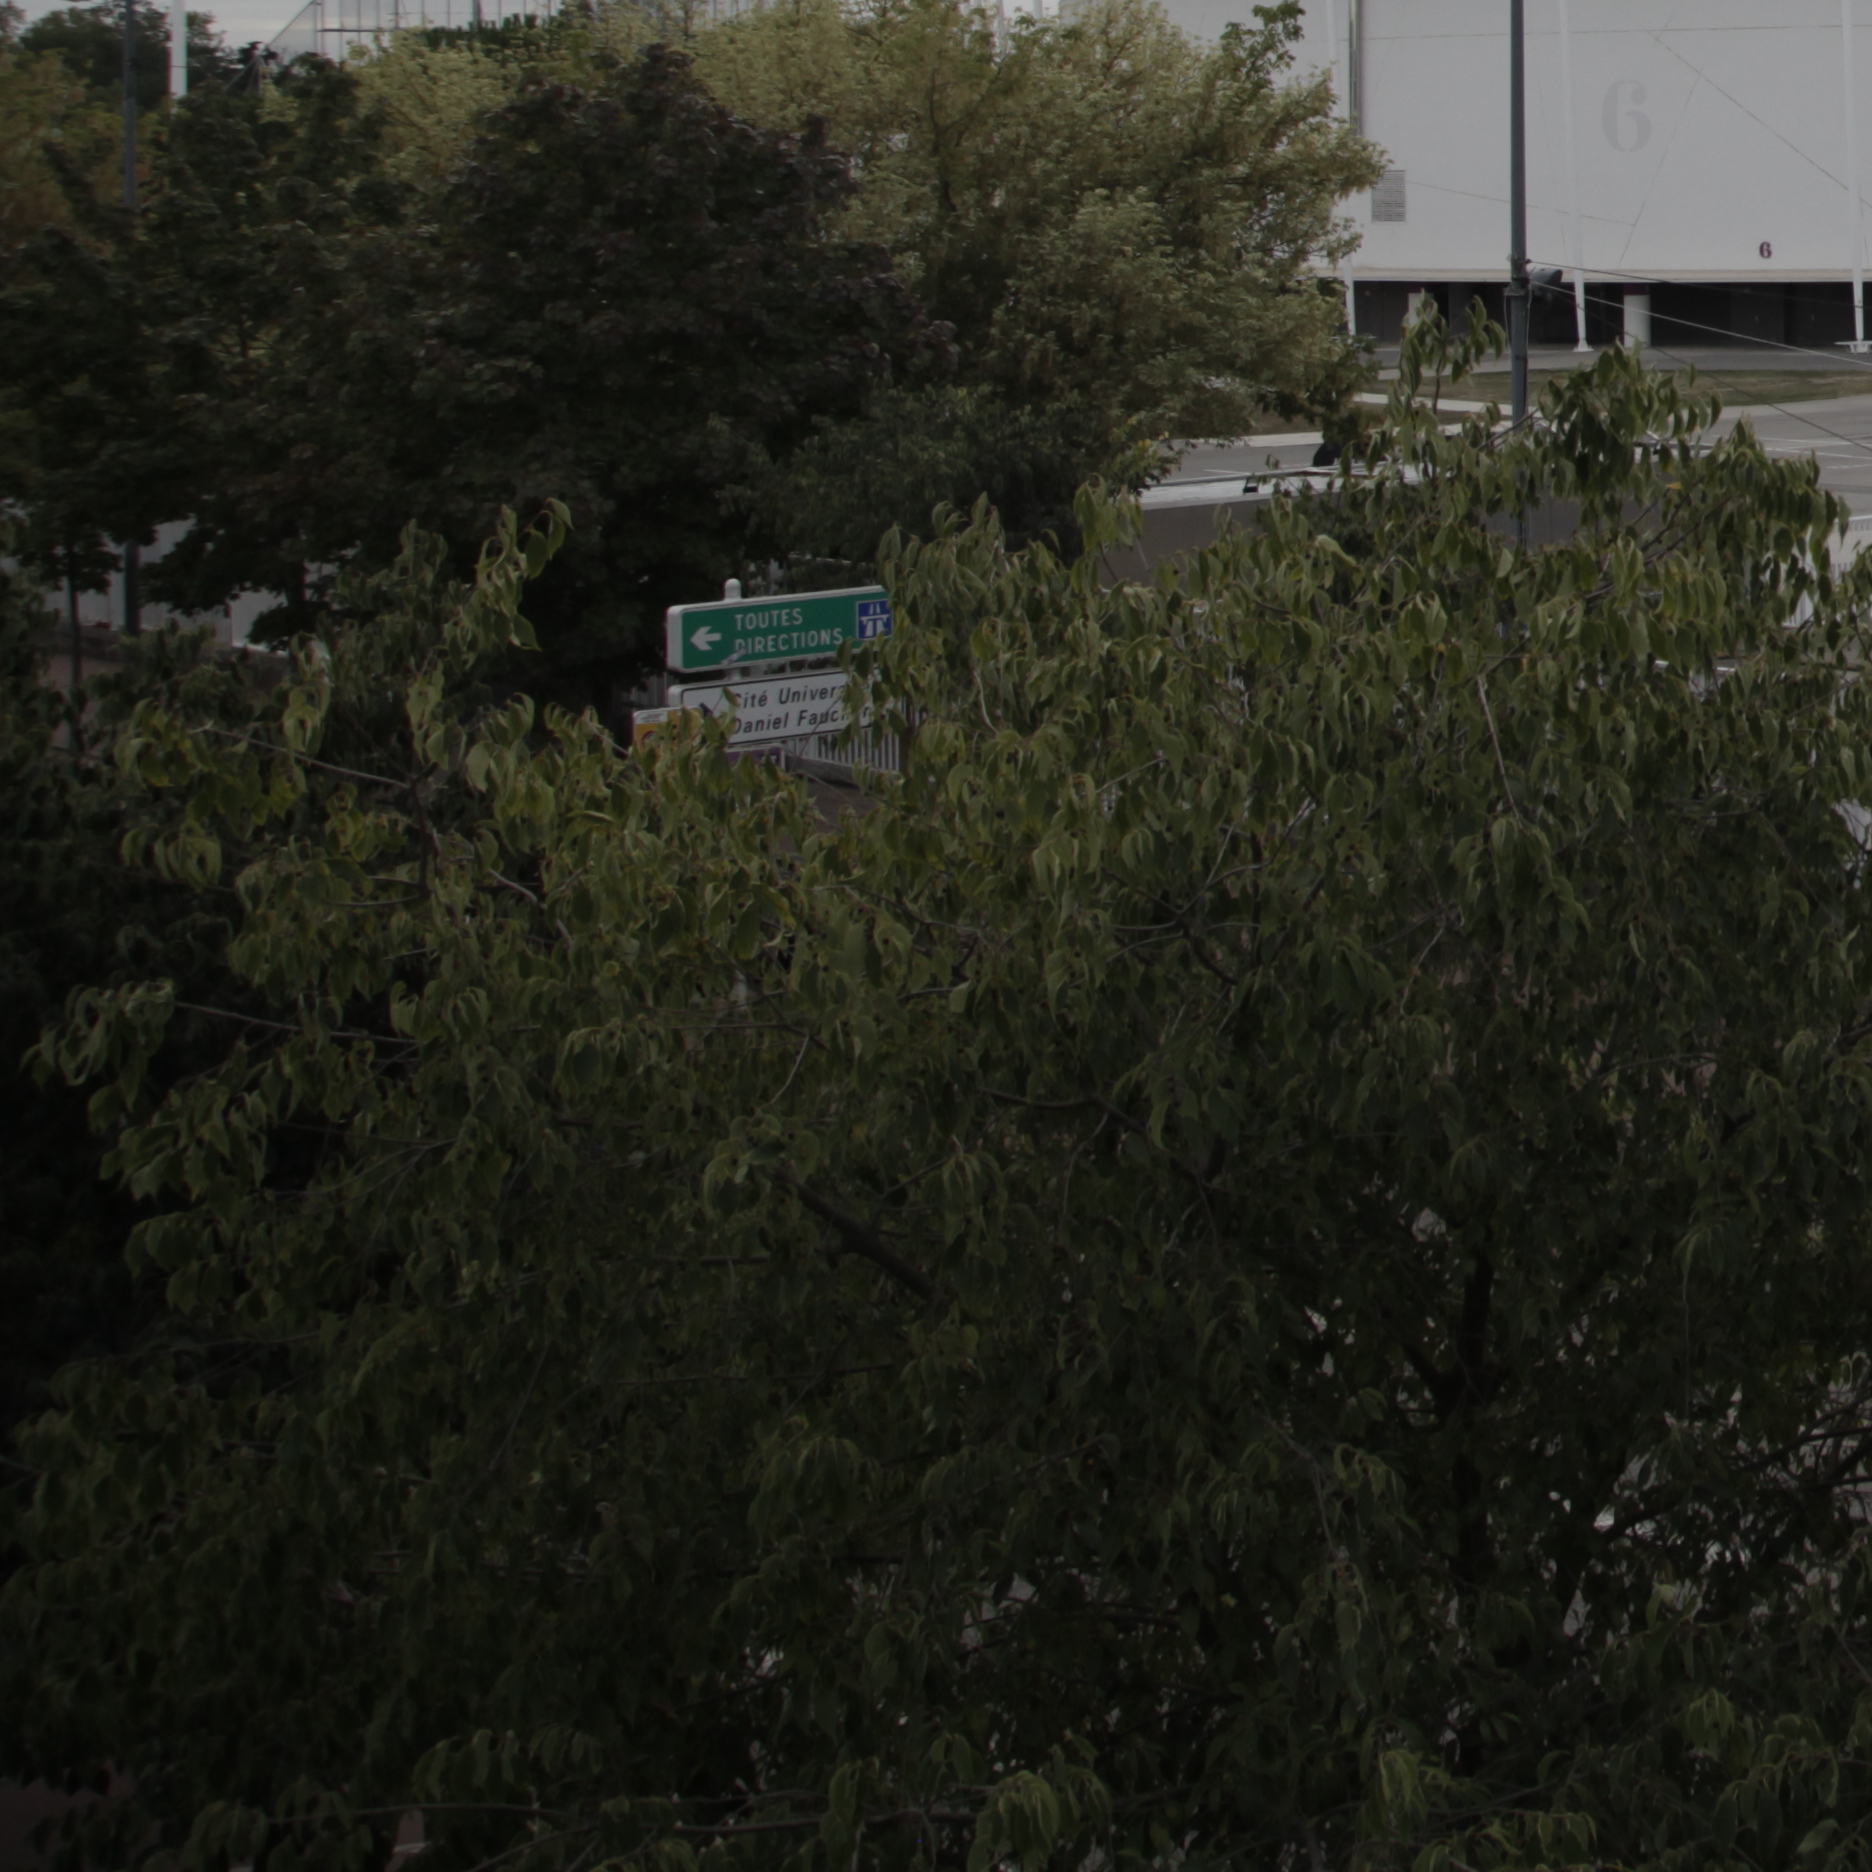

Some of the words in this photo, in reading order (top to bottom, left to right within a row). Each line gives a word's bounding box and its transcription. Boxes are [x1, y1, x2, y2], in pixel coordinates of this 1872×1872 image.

[1602, 79, 1652, 153] 6
[1759, 241, 1772, 258] 6
[734, 608, 803, 631] TOUTES
[734, 628, 843, 655] DIRECTIONS
[734, 712, 789, 734] Daniel
